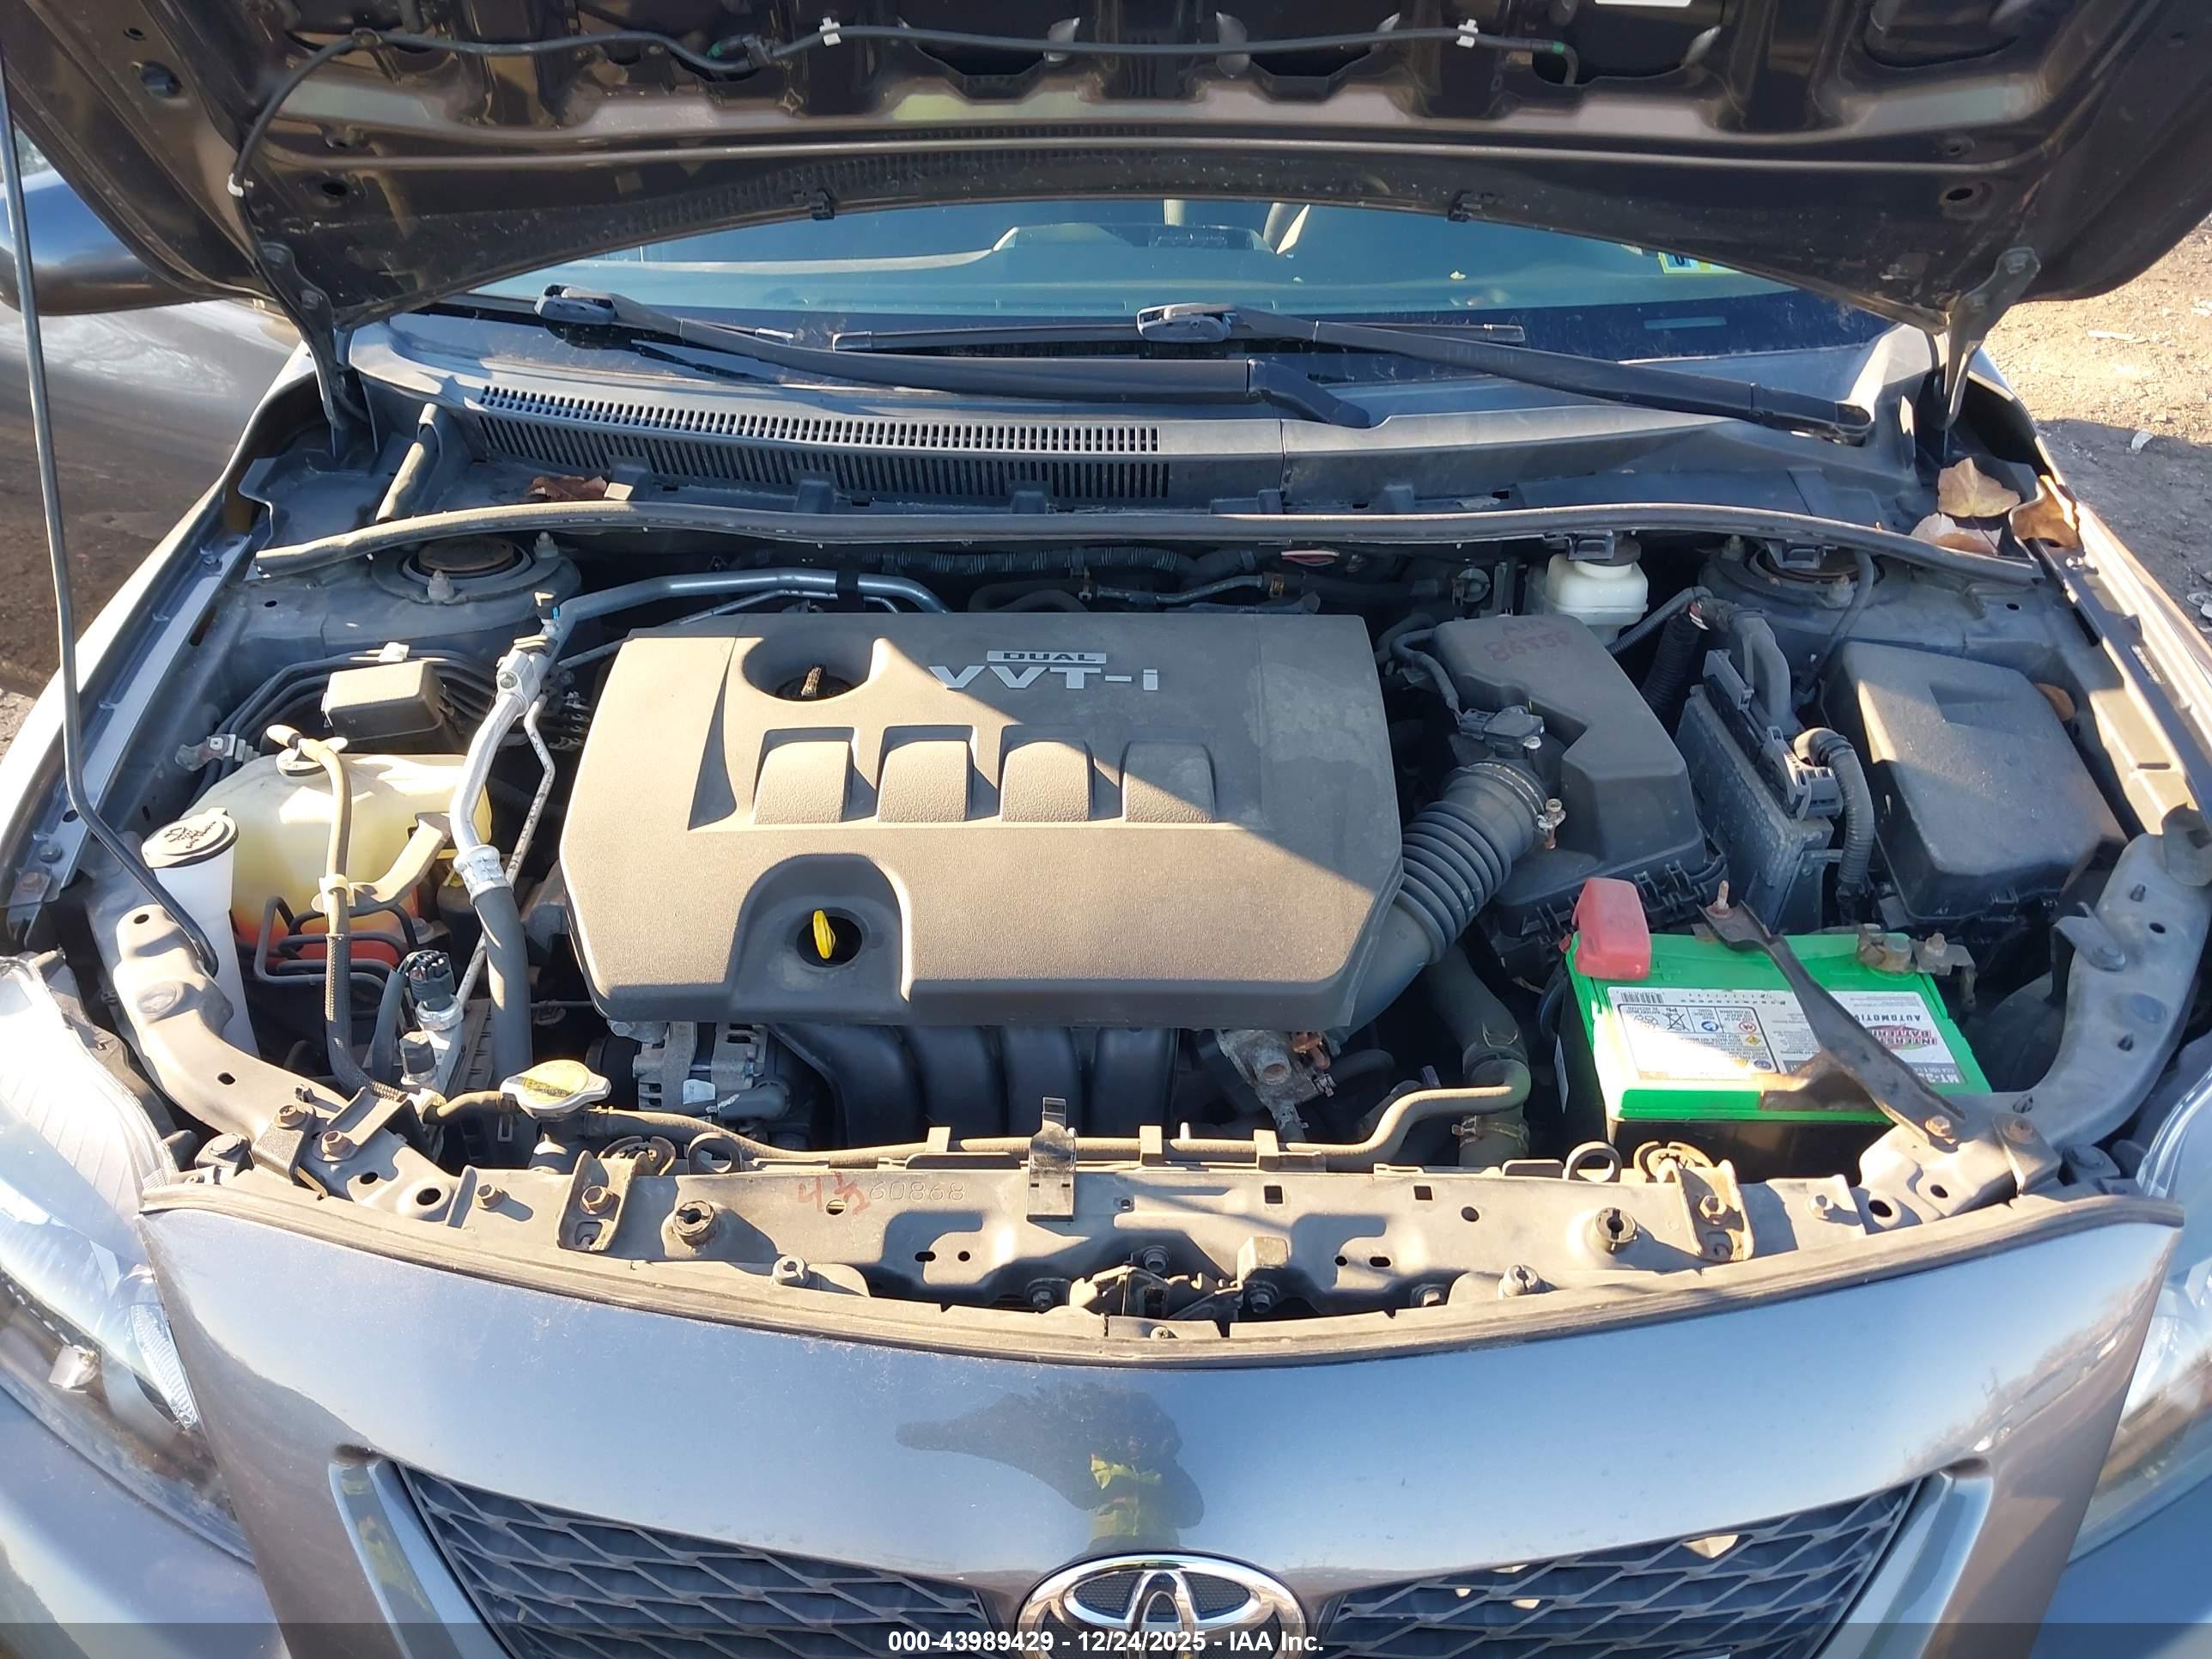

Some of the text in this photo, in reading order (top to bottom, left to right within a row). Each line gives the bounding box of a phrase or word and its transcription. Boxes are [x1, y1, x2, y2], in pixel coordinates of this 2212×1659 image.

[1003, 652, 1097, 661] DUAL
[927, 665, 1158, 690] VVT-i
[869, 1181, 966, 1202] 60868
